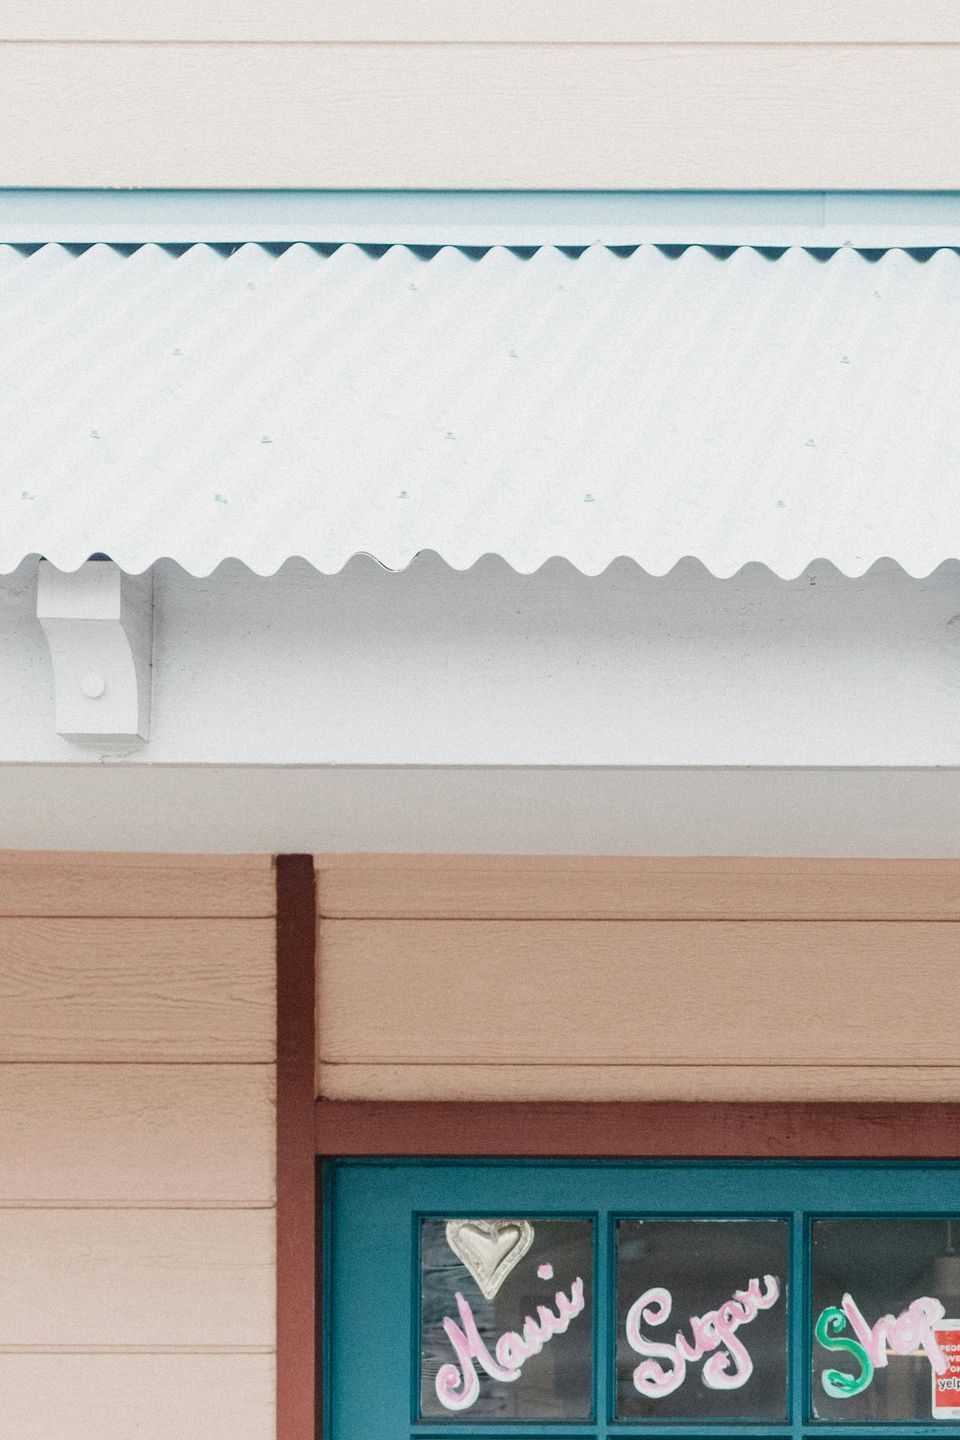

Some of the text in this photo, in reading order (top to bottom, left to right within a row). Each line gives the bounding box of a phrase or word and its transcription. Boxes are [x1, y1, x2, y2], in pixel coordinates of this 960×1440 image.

[436, 1263, 585, 1410] Maui
[626, 1273, 780, 1398] Sugar
[815, 1292, 947, 1399] Shop
